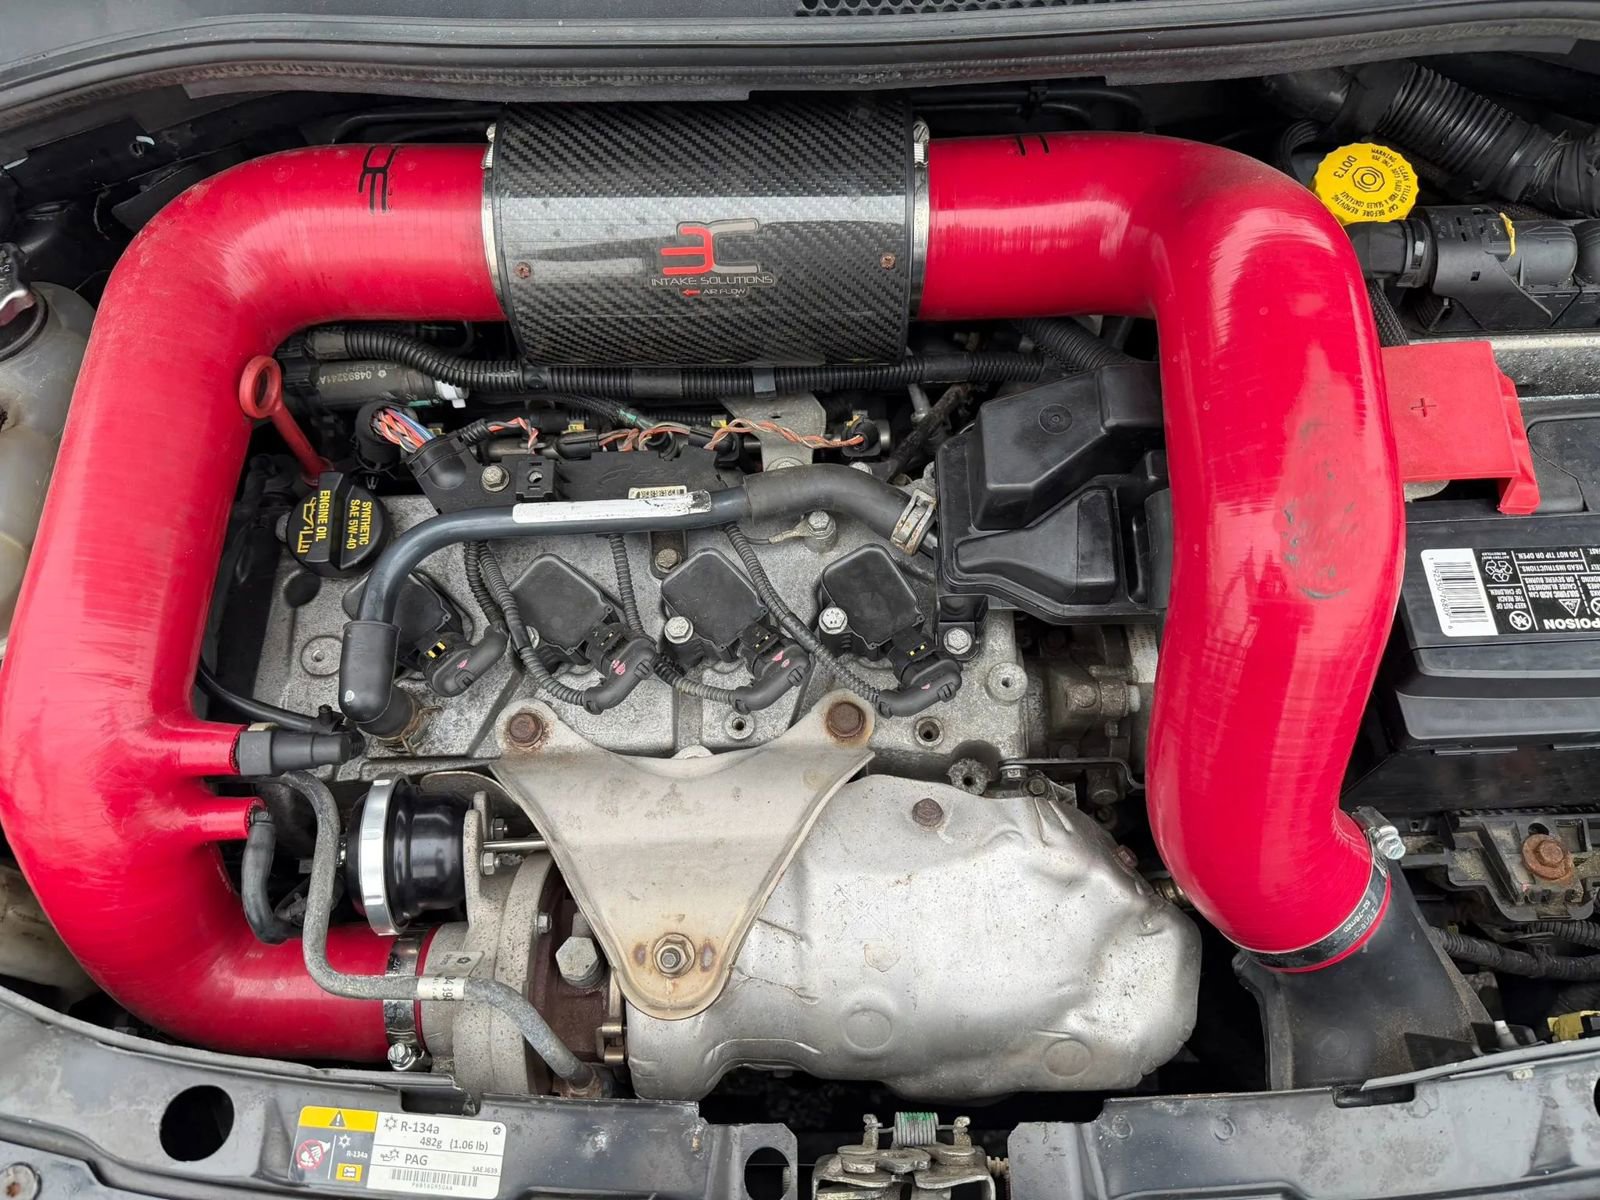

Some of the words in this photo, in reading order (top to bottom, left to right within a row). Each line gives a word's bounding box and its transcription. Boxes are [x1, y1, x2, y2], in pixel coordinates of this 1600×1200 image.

[1398, 165, 1410, 182] CLEAN
[1400, 185, 1411, 203] FILLER
[1362, 208, 1385, 218] BEFORE
[1388, 204, 1399, 213] CAP
[652, 278, 697, 286] INTAKE
[700, 276, 773, 286] SOLUTIONS
[317, 370, 372, 384] 04893241A
[318, 490, 330, 524] ENGINE
[350, 499, 360, 518] SAE
[359, 502, 372, 546] SYNTHETIC
[316, 526, 327, 542] OIL
[346, 519, 358, 549] 5W-40
[1553, 590, 1580, 598] SULFURIC
[400, 1120, 440, 1134] R-134a
[420, 1134, 442, 1149] 482g
[450, 1138, 474, 1149] (1.06
[476, 1141, 488, 1152] lb)
[346, 1150, 368, 1158] R-134a
[405, 1154, 428, 1166] PAG
